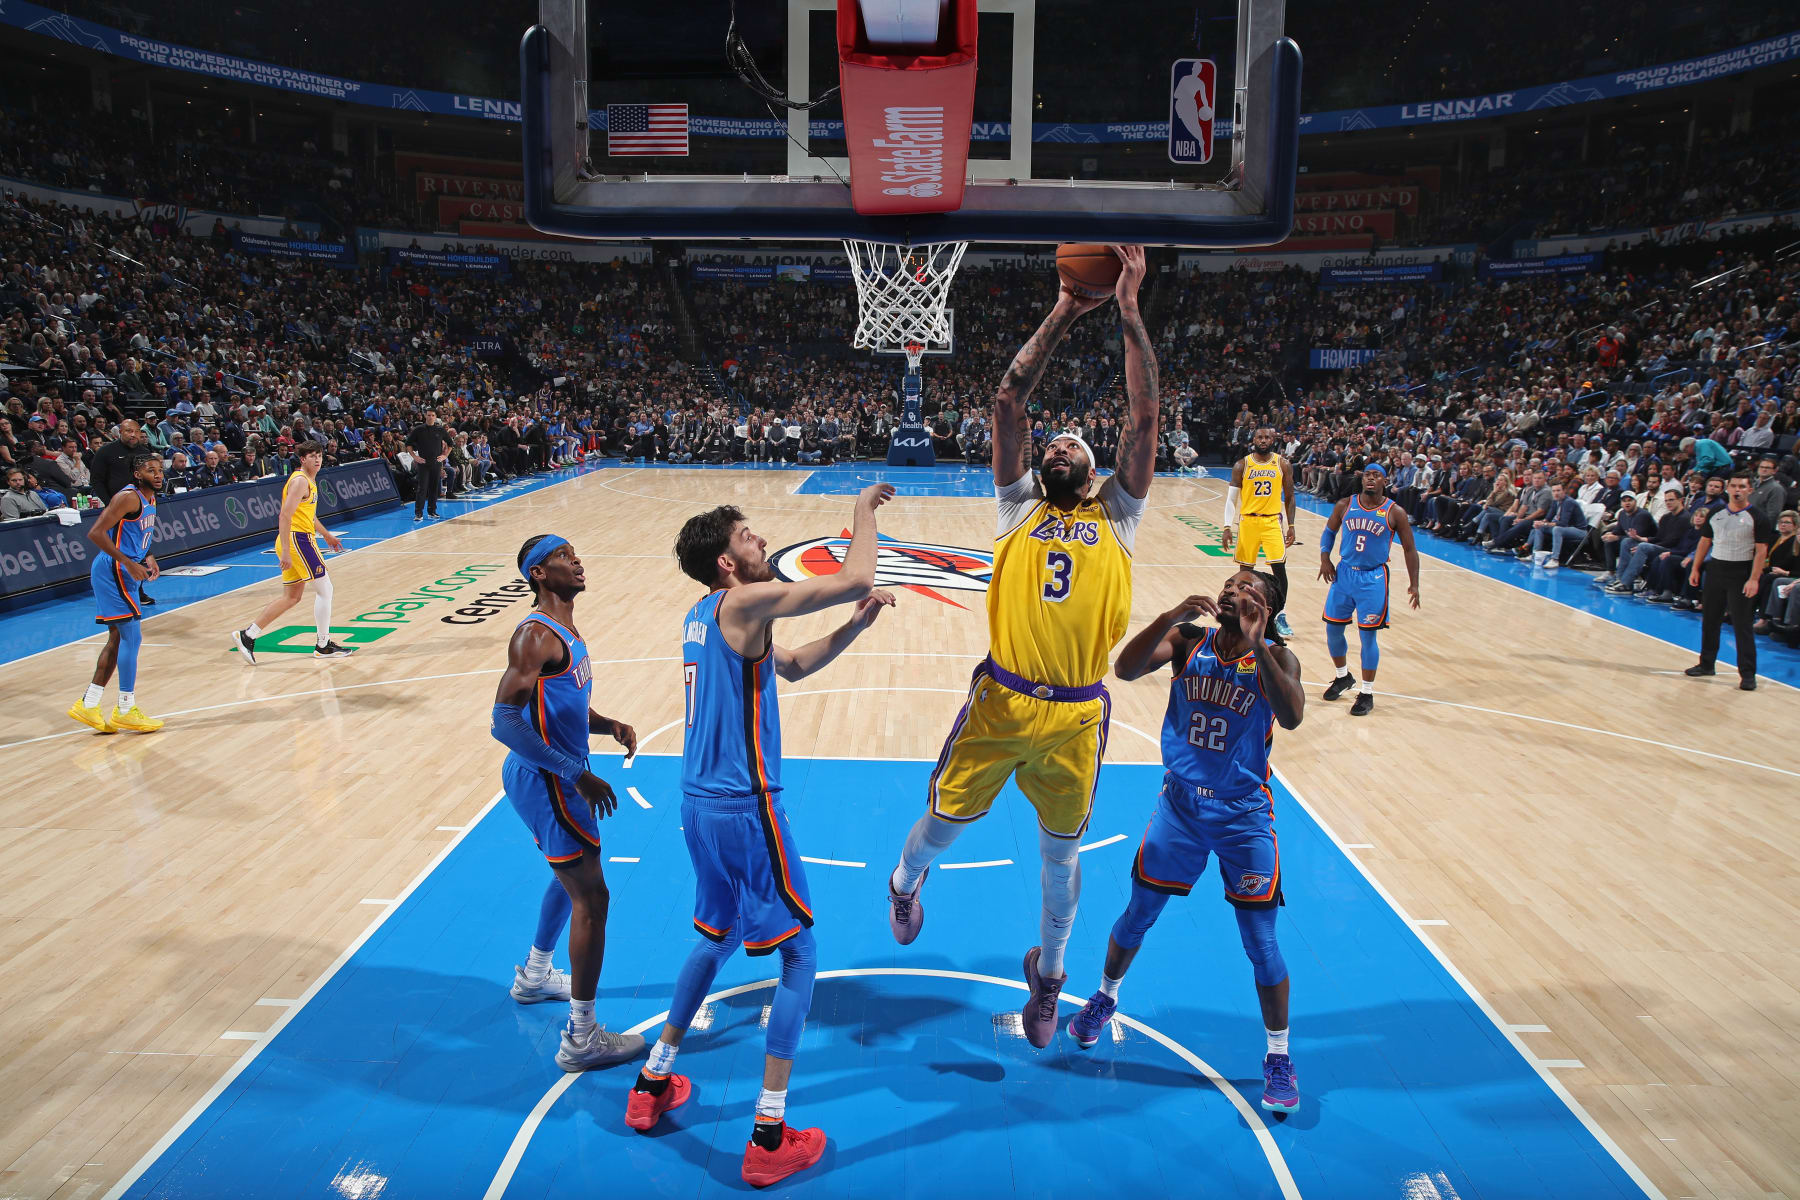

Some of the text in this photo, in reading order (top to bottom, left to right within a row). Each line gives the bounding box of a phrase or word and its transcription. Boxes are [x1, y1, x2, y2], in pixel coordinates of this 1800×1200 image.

[120, 34, 361, 92] PROUD HOMEBUILDING PARTNER OF
[137, 49, 346, 98] THE OKLAHOMA CITY THUNDER
[1615, 67, 1669, 85] PROUD
[1672, 37, 1789, 74] HOMEBUILDING
[1634, 77, 1664, 90] THE
[1666, 58, 1752, 84] OKLAHOMA
[1753, 48, 1788, 66] CITY
[453, 95, 522, 117] LENN
[1401, 94, 1514, 120] LENNAR
[688, 118, 771, 129] HOMEBUILDING
[828, 122, 844, 130] OF
[1107, 124, 1148, 133] PROUD
[1121, 131, 1144, 140] THE
[1175, 140, 1196, 157] NBA
[288, 241, 345, 252] HOMEBUILDER
[447, 254, 500, 265] HOMEBUILDER
[1489, 262, 1523, 270] Oklahoma's
[335, 479, 370, 500] Globe
[368, 471, 391, 497] Life
[1248, 469, 1277, 480] LAKERS
[1254, 481, 1272, 497] 23
[247, 494, 283, 520] Glob
[183, 506, 221, 536] Life
[1345, 518, 1385, 537] THUNDER
[34, 533, 87, 568] Life
[1355, 535, 1366, 552] 5
[1043, 551, 1074, 603] 3
[348, 563, 505, 624] paycom
[684, 662, 698, 729] 7
[1184, 676, 1257, 718] THUNDER
[1188, 711, 1229, 753] 22
[1197, 786, 1214, 799] OKC
